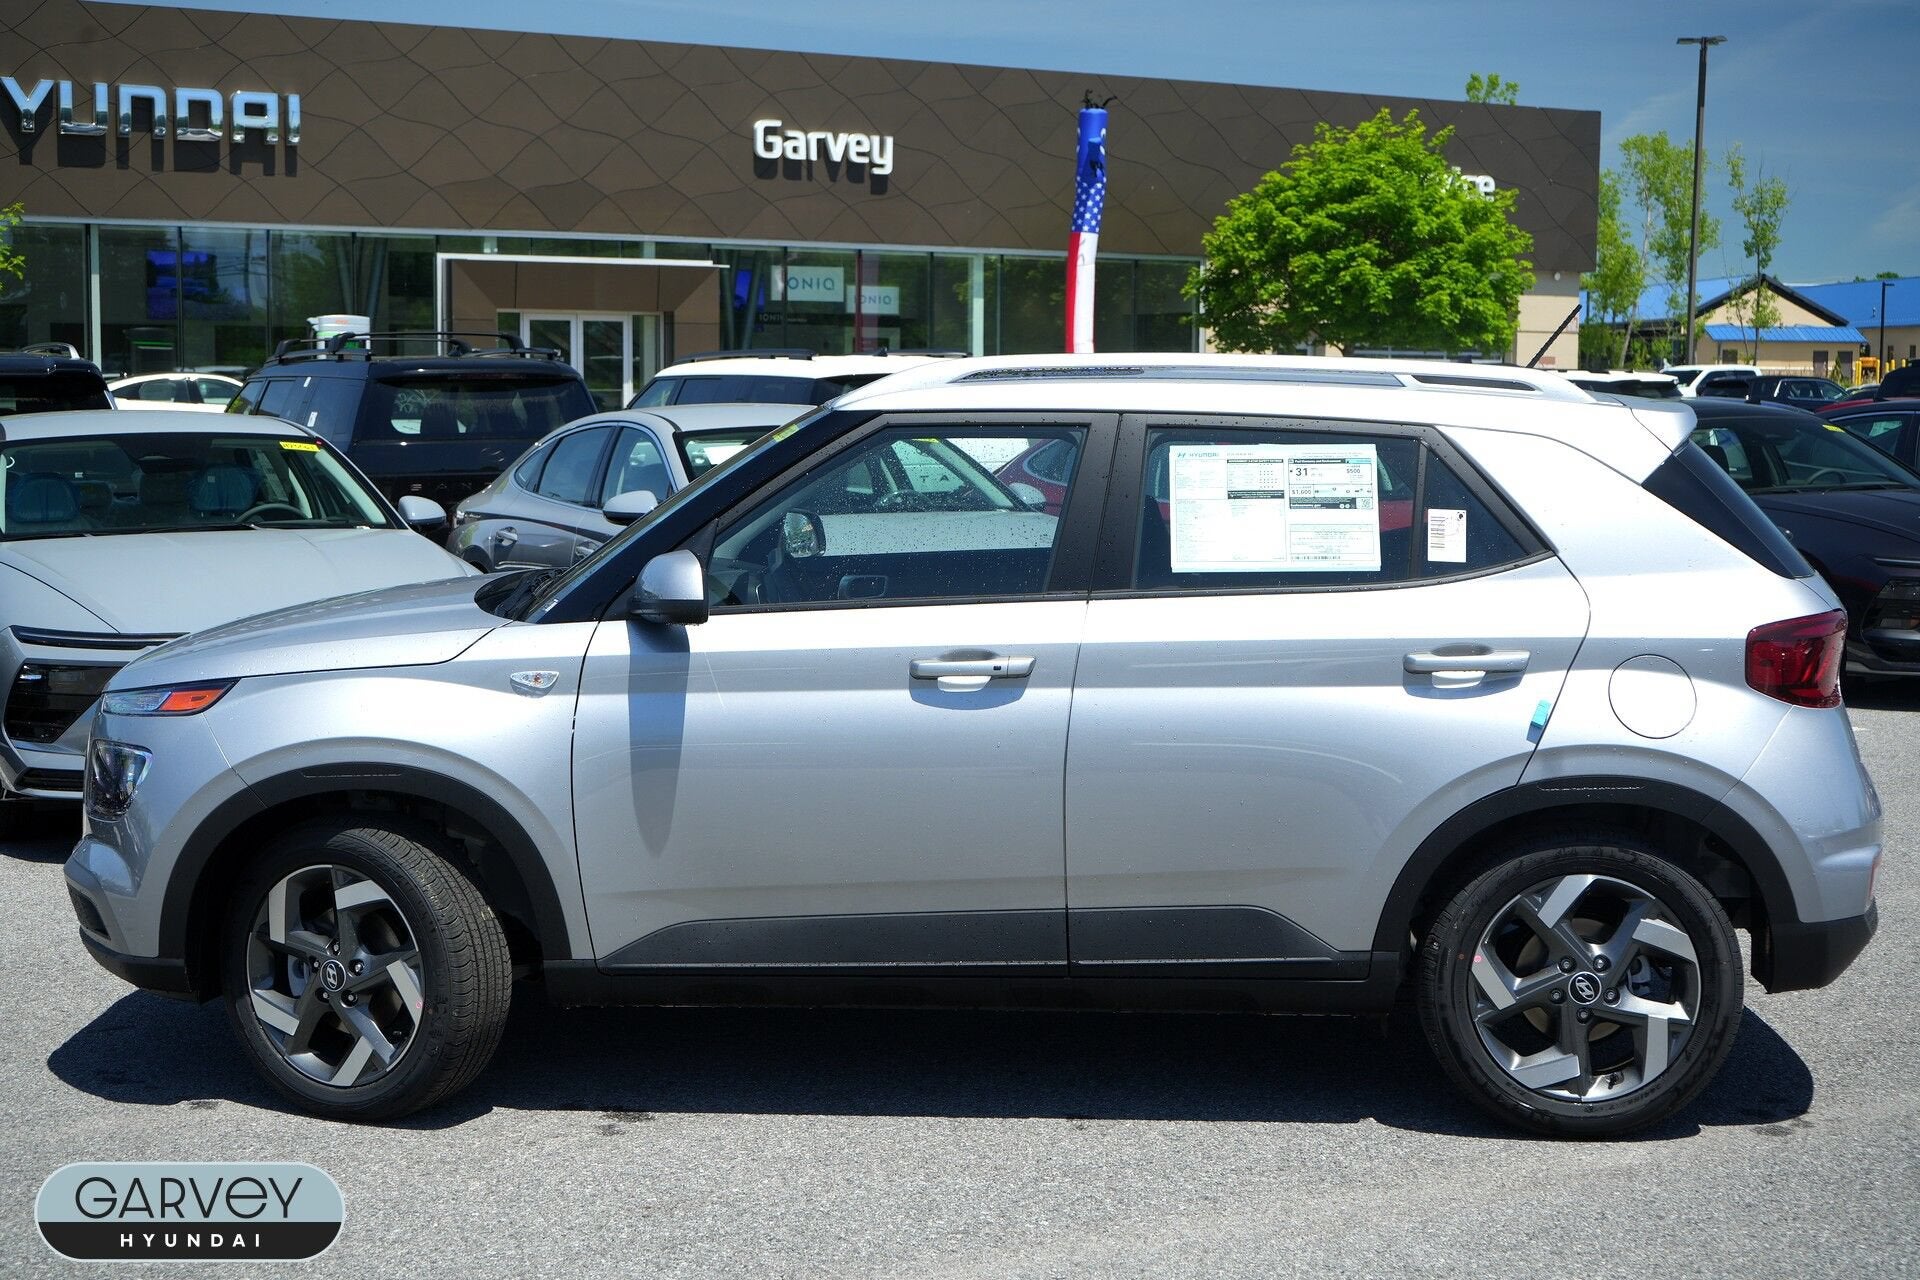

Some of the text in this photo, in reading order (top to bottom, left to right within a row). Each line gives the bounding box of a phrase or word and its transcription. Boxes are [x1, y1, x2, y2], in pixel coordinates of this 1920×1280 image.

[753, 118, 894, 175] Garvey
[785, 276, 835, 291] ONIQ
[1295, 467, 1308, 477] 31
